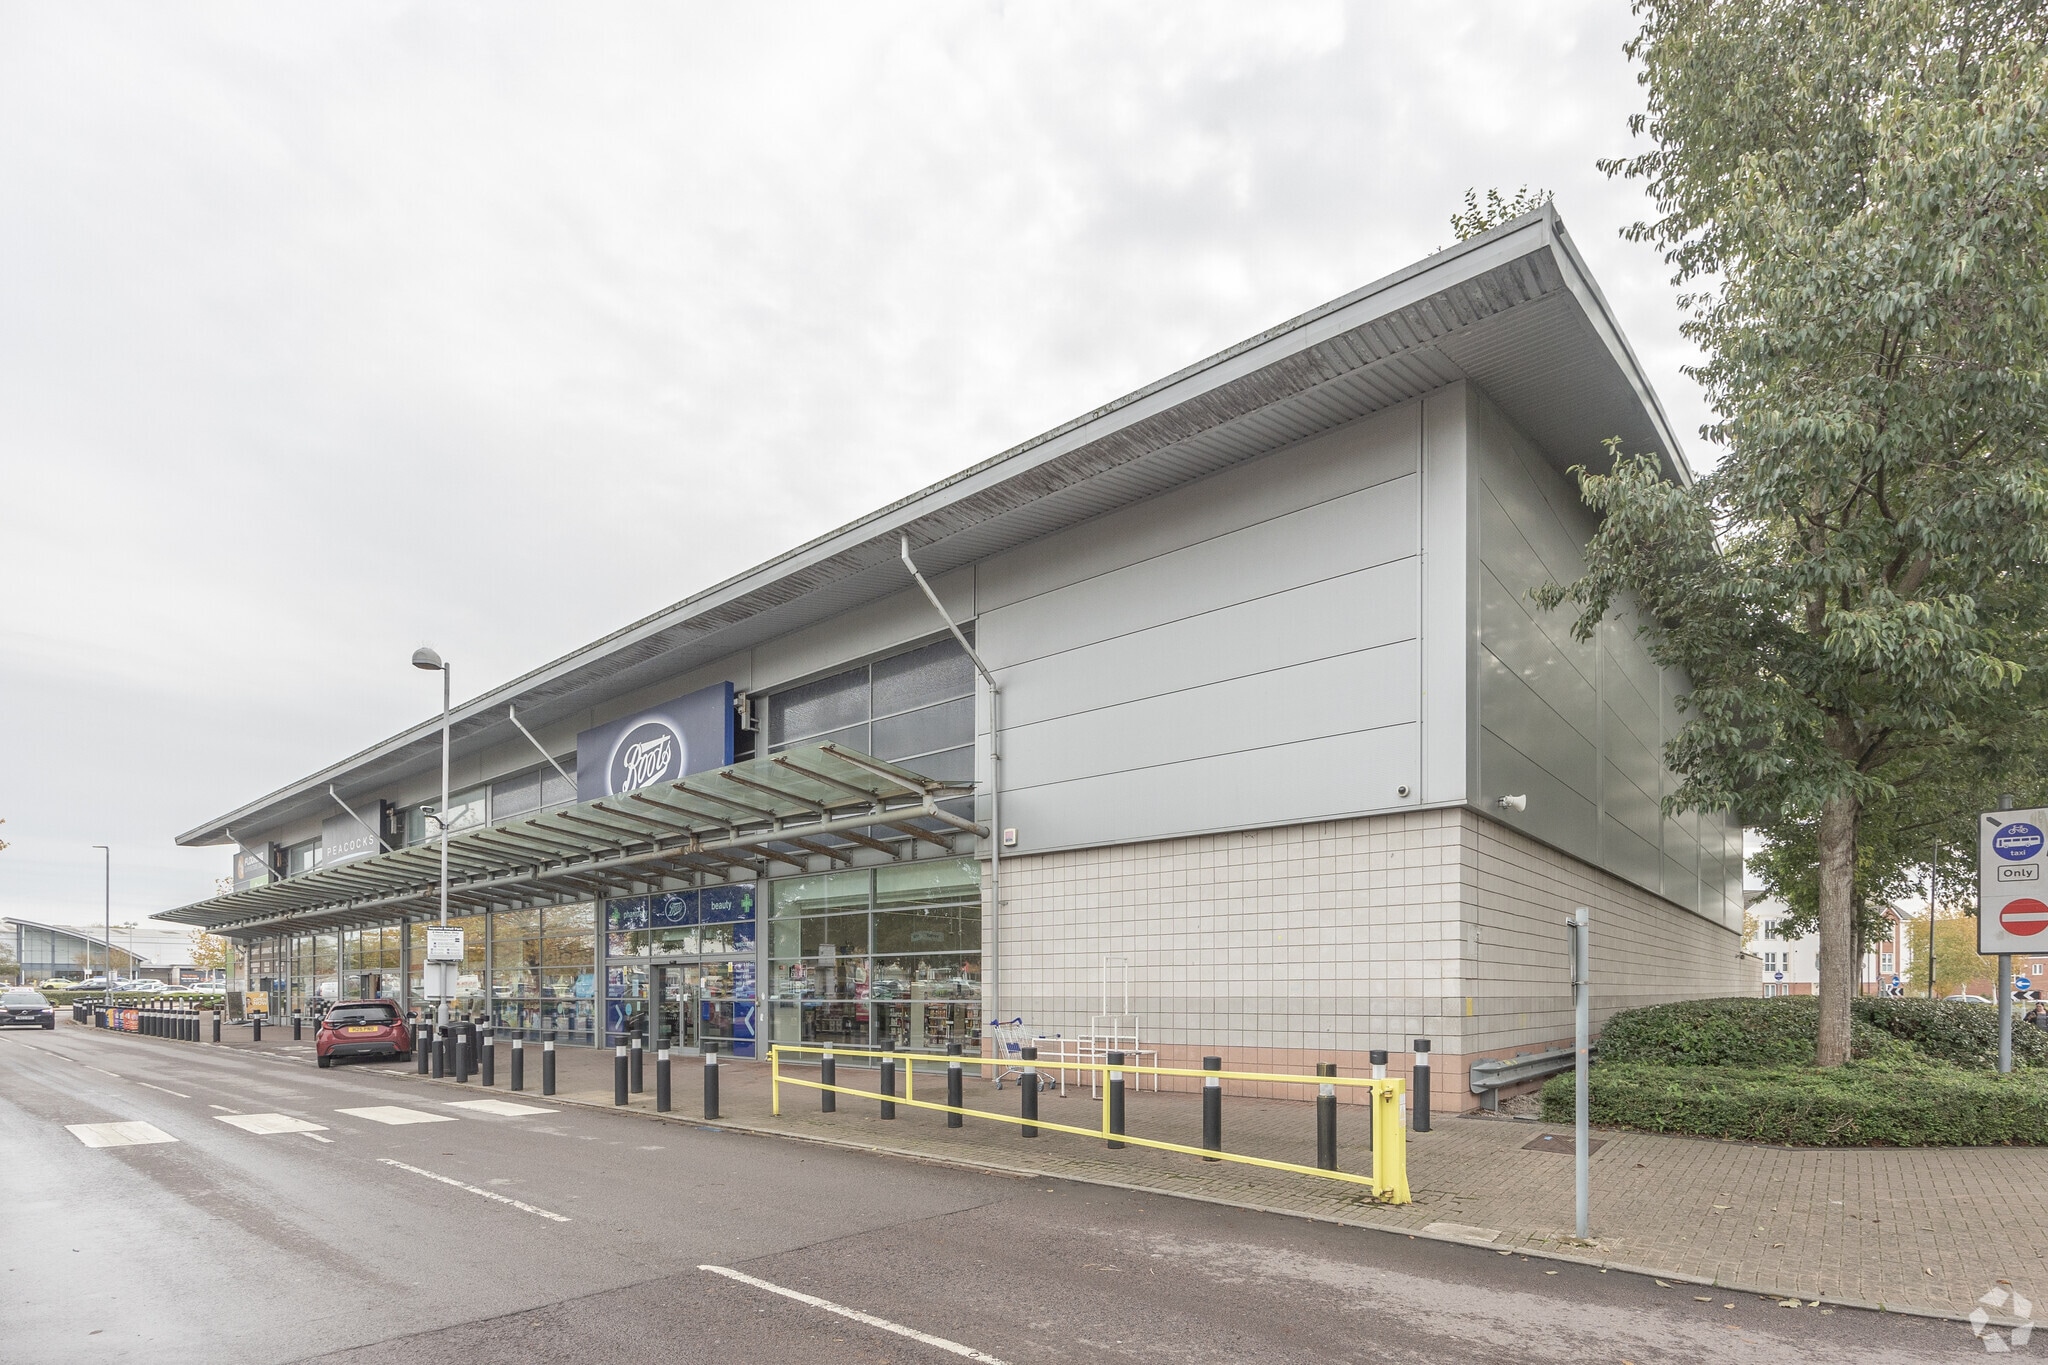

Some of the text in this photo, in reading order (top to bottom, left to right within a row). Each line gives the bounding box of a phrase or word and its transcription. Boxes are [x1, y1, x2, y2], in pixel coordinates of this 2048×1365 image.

[622, 734, 671, 792] Boots
[327, 834, 374, 857] PEACOCKS
[2003, 869, 2033, 878] Only
[711, 900, 732, 911] beauty
